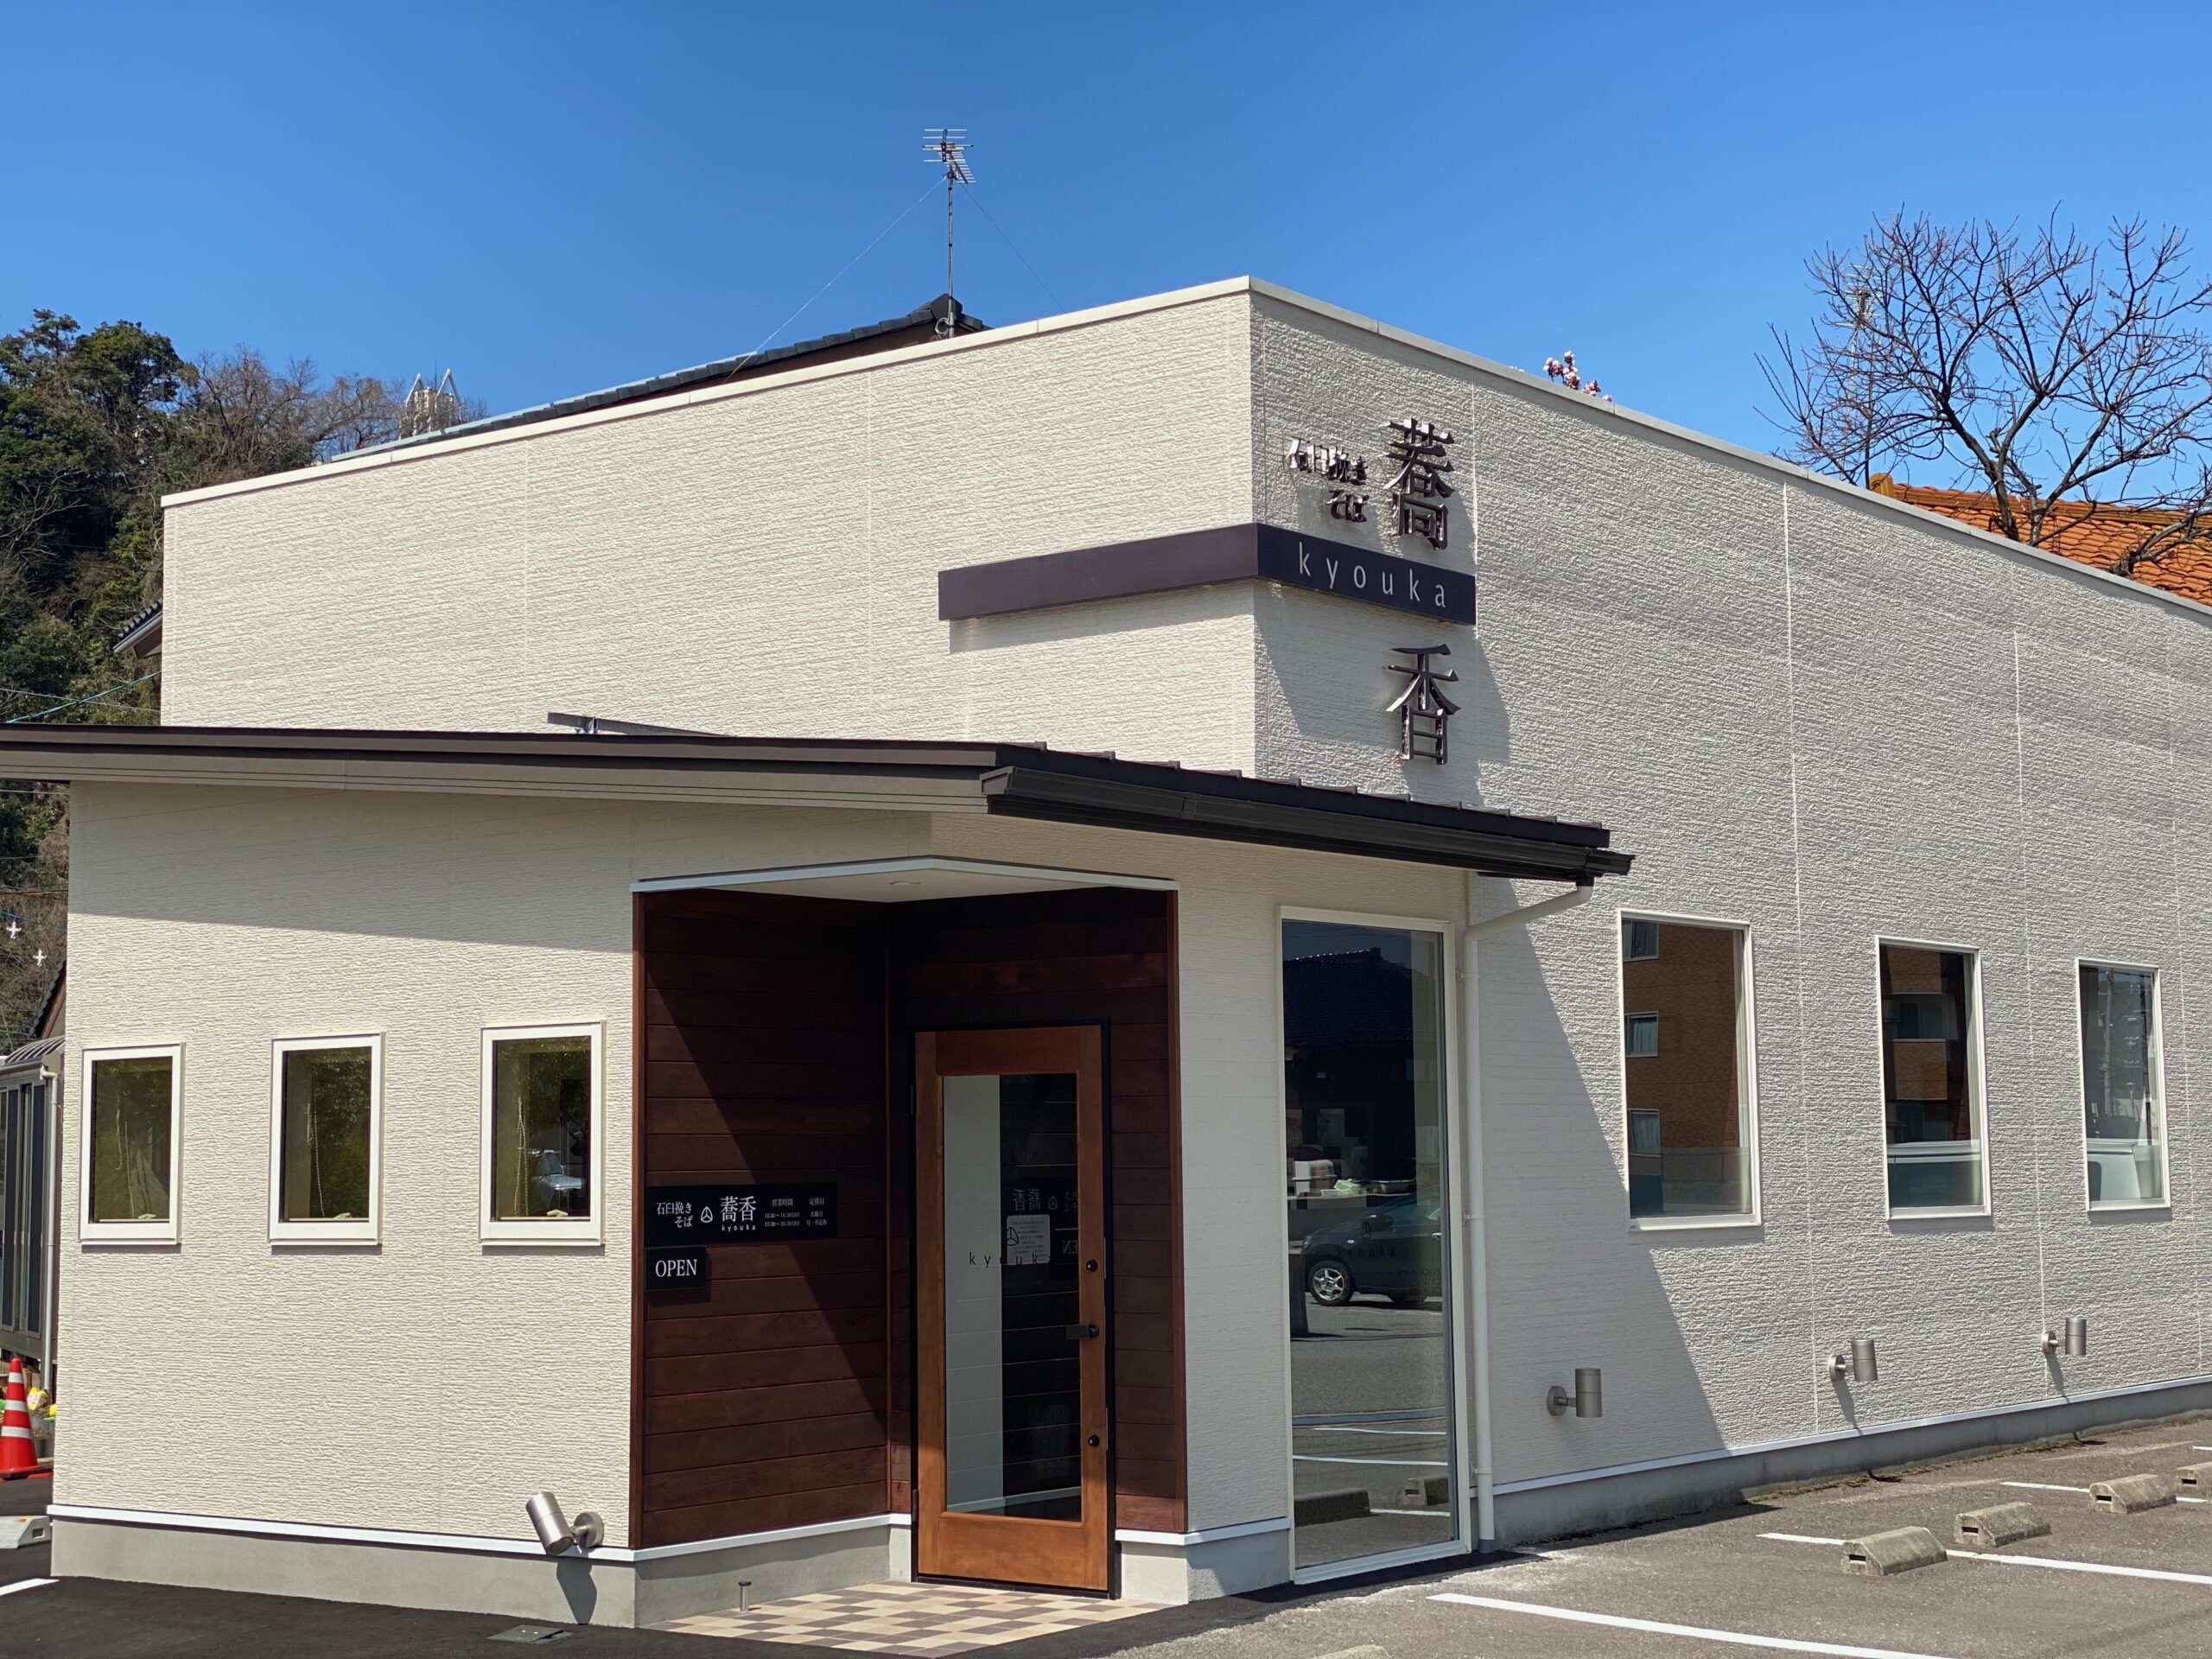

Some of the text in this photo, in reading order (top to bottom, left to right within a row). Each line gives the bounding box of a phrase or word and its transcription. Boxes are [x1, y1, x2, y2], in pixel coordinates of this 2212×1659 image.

[1299, 541, 1446, 608] kyouka
[656, 1201, 692, 1216] 石臼挽き
[720, 1196, 757, 1223] 蕎香
[674, 1215, 693, 1228] そば
[655, 1259, 697, 1278] OPEN
